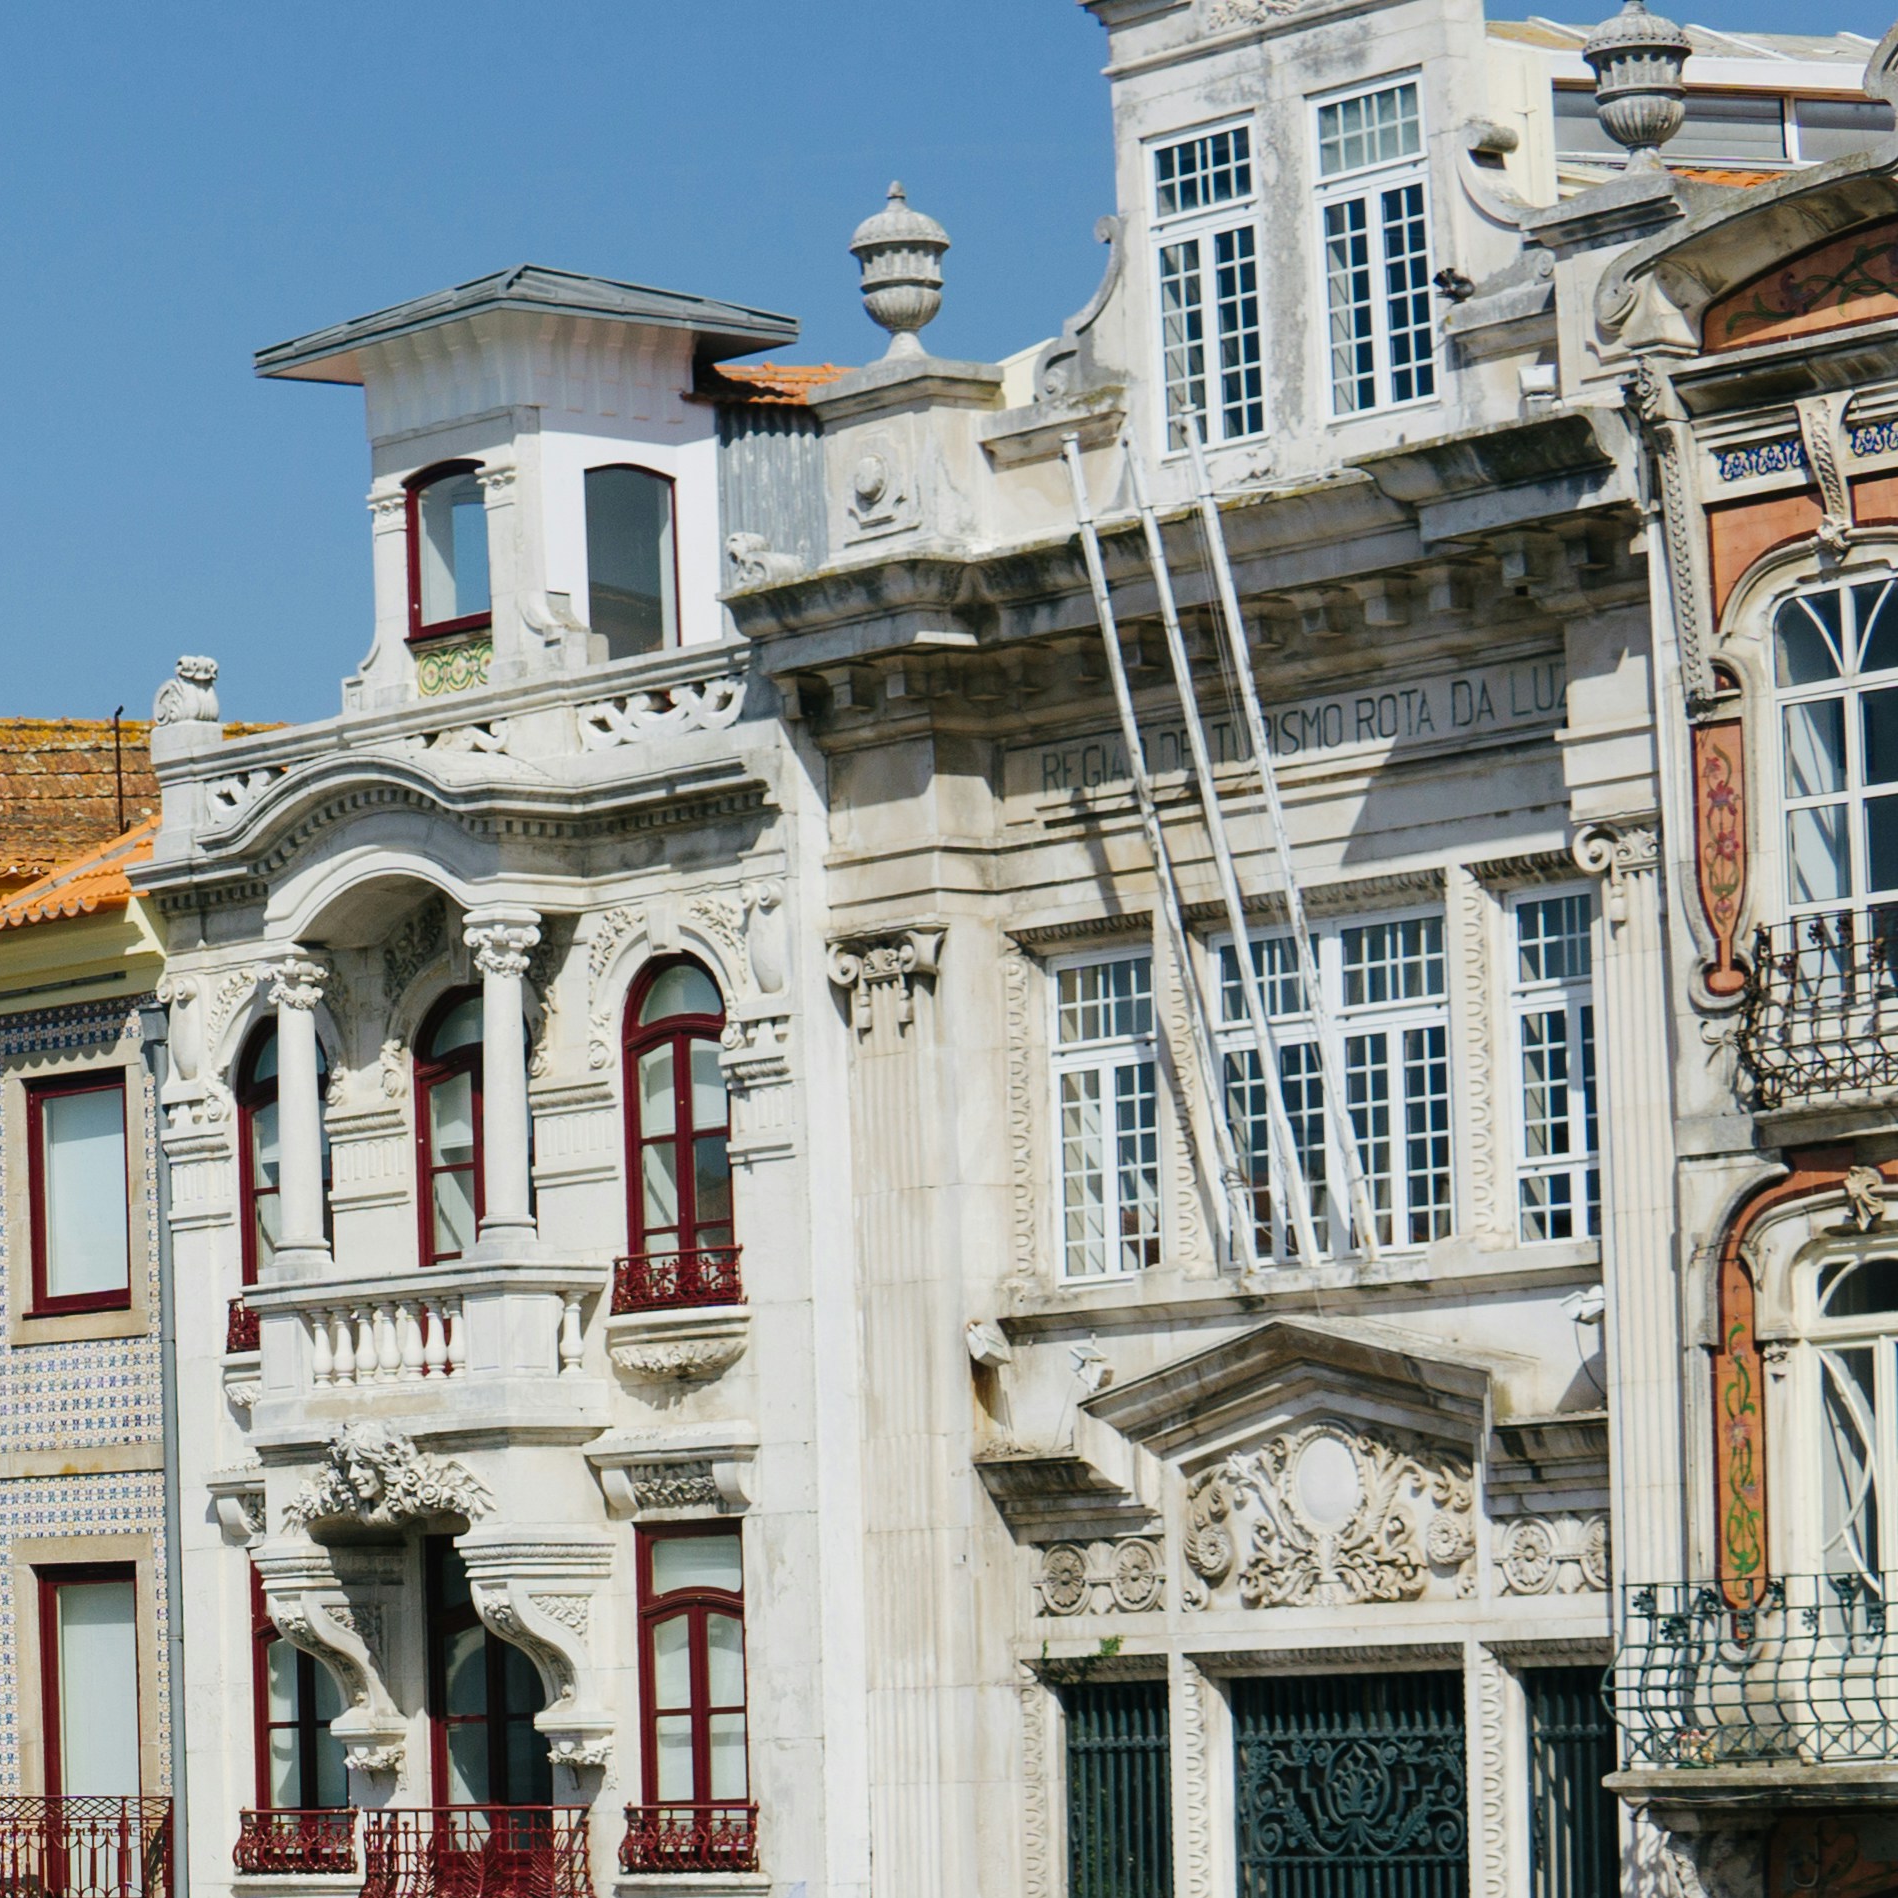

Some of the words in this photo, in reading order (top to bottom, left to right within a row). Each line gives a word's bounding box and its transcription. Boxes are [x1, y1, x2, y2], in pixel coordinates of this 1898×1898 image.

[1041, 733, 1147, 796] REGIÃ
[1355, 688, 1435, 744] ROTA
[1450, 678, 1495, 727] DA
